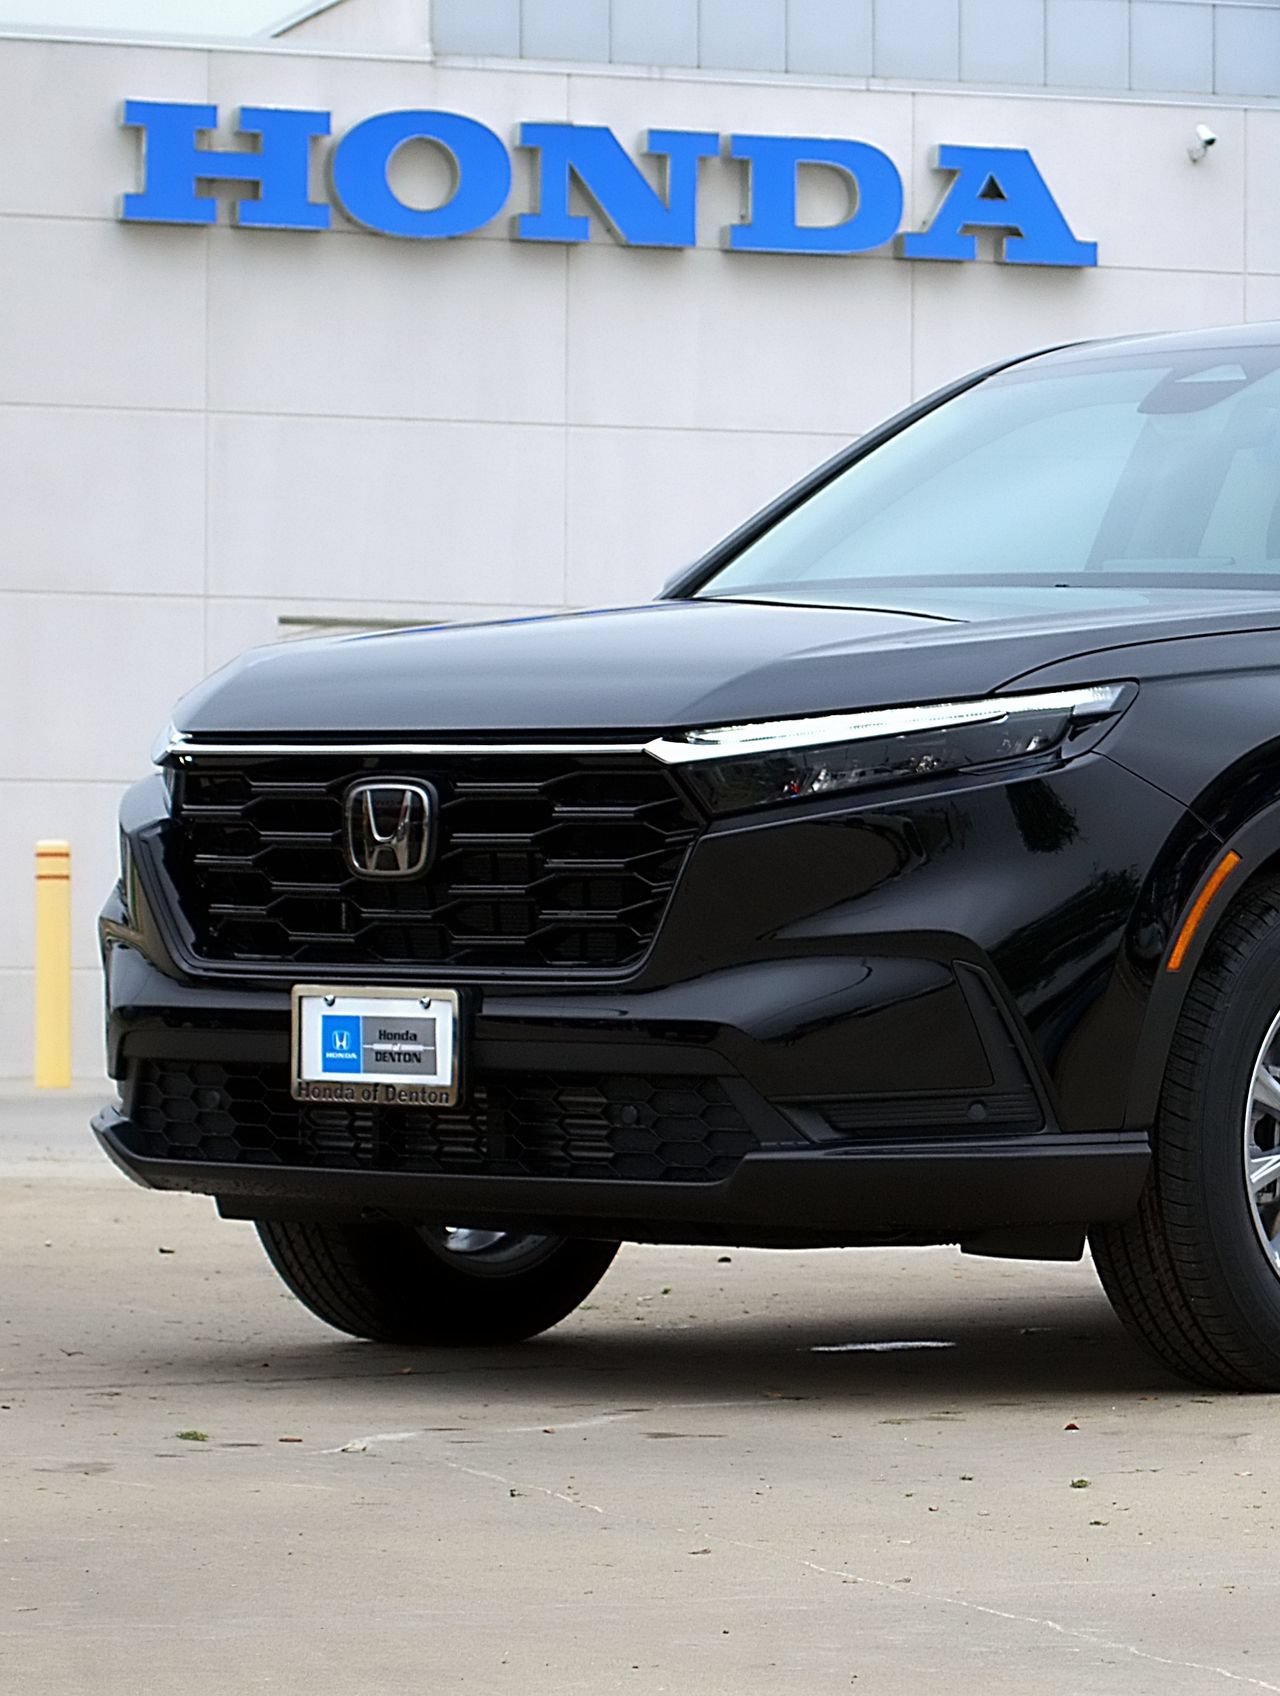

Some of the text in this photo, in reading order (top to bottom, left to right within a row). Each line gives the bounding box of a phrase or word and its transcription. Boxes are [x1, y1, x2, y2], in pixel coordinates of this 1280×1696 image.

[121, 98, 1098, 268] HONDA
[378, 1029, 417, 1042] Honda
[325, 1051, 358, 1060] HONDA
[374, 1051, 422, 1064] DENTON
[297, 1081, 450, 1104] Honda of Denton
